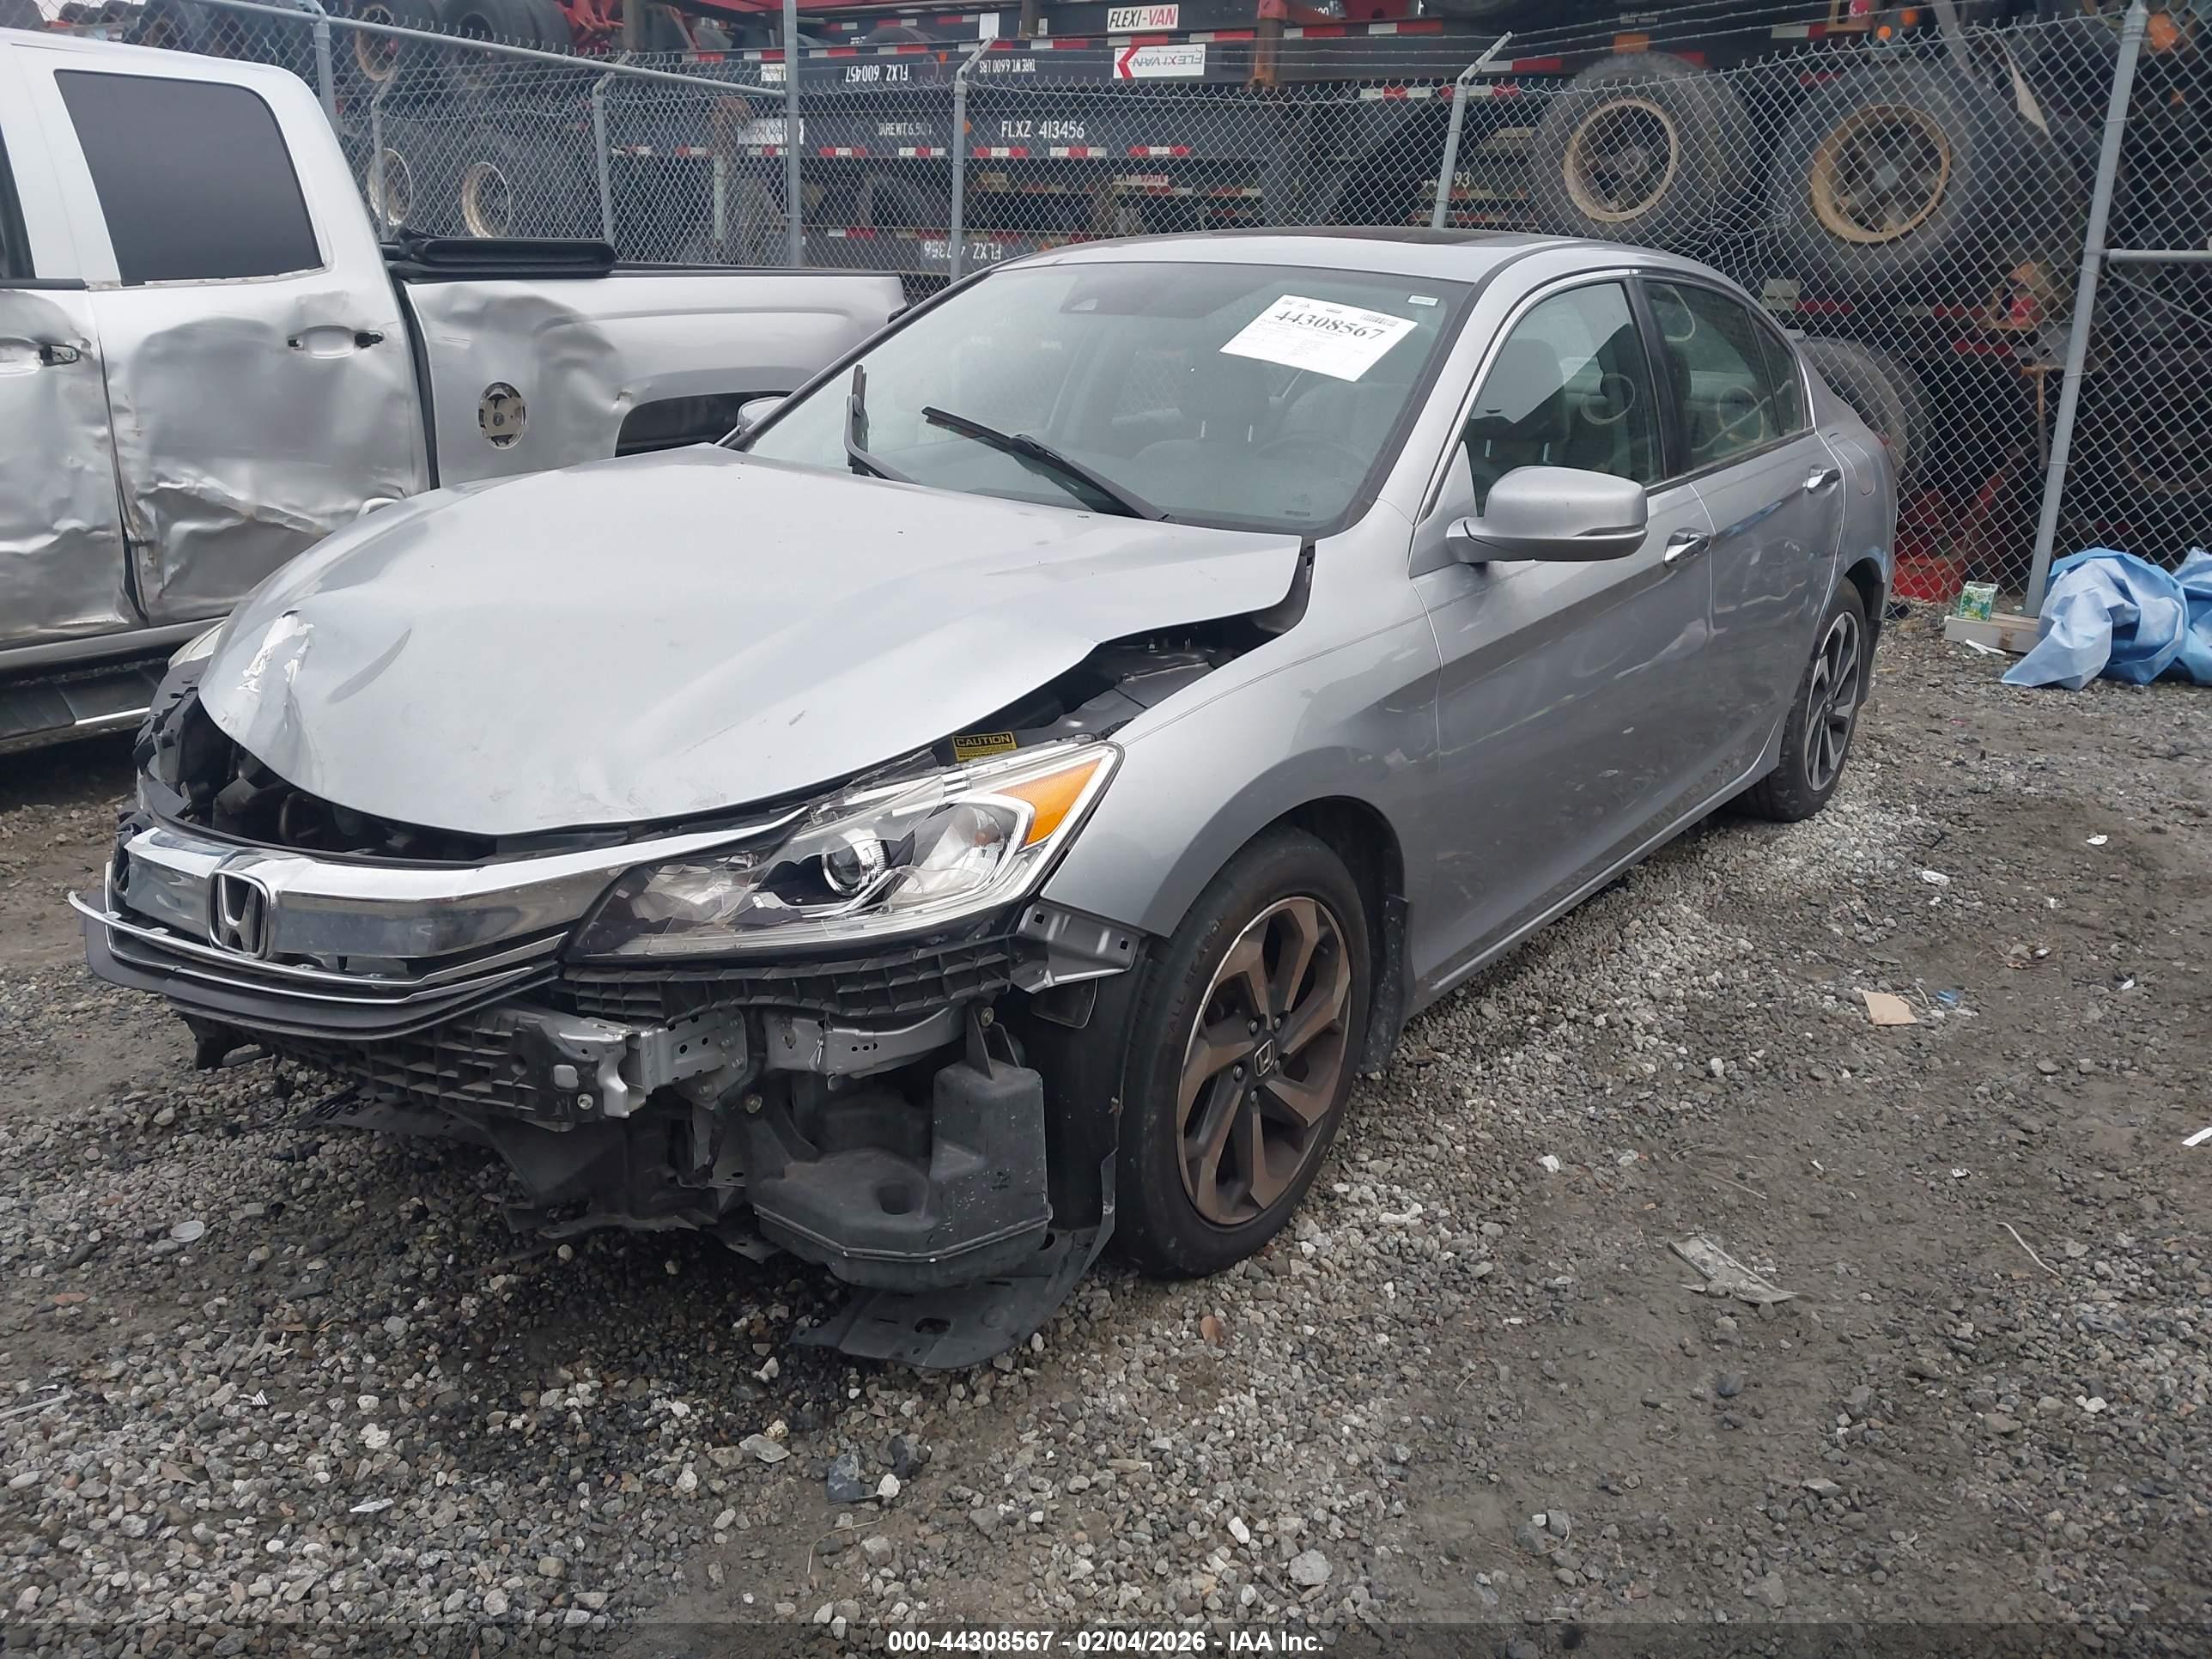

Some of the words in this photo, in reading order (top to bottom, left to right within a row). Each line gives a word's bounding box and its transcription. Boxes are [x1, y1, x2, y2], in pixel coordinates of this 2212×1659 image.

[845, 64, 880, 82] 600457
[885, 64, 908, 82] FLXZ
[1001, 120, 1032, 137] FLXZ
[1038, 120, 1085, 139] 413456
[1274, 311, 1386, 340] 44308567
[956, 734, 1011, 747] CAUTION
